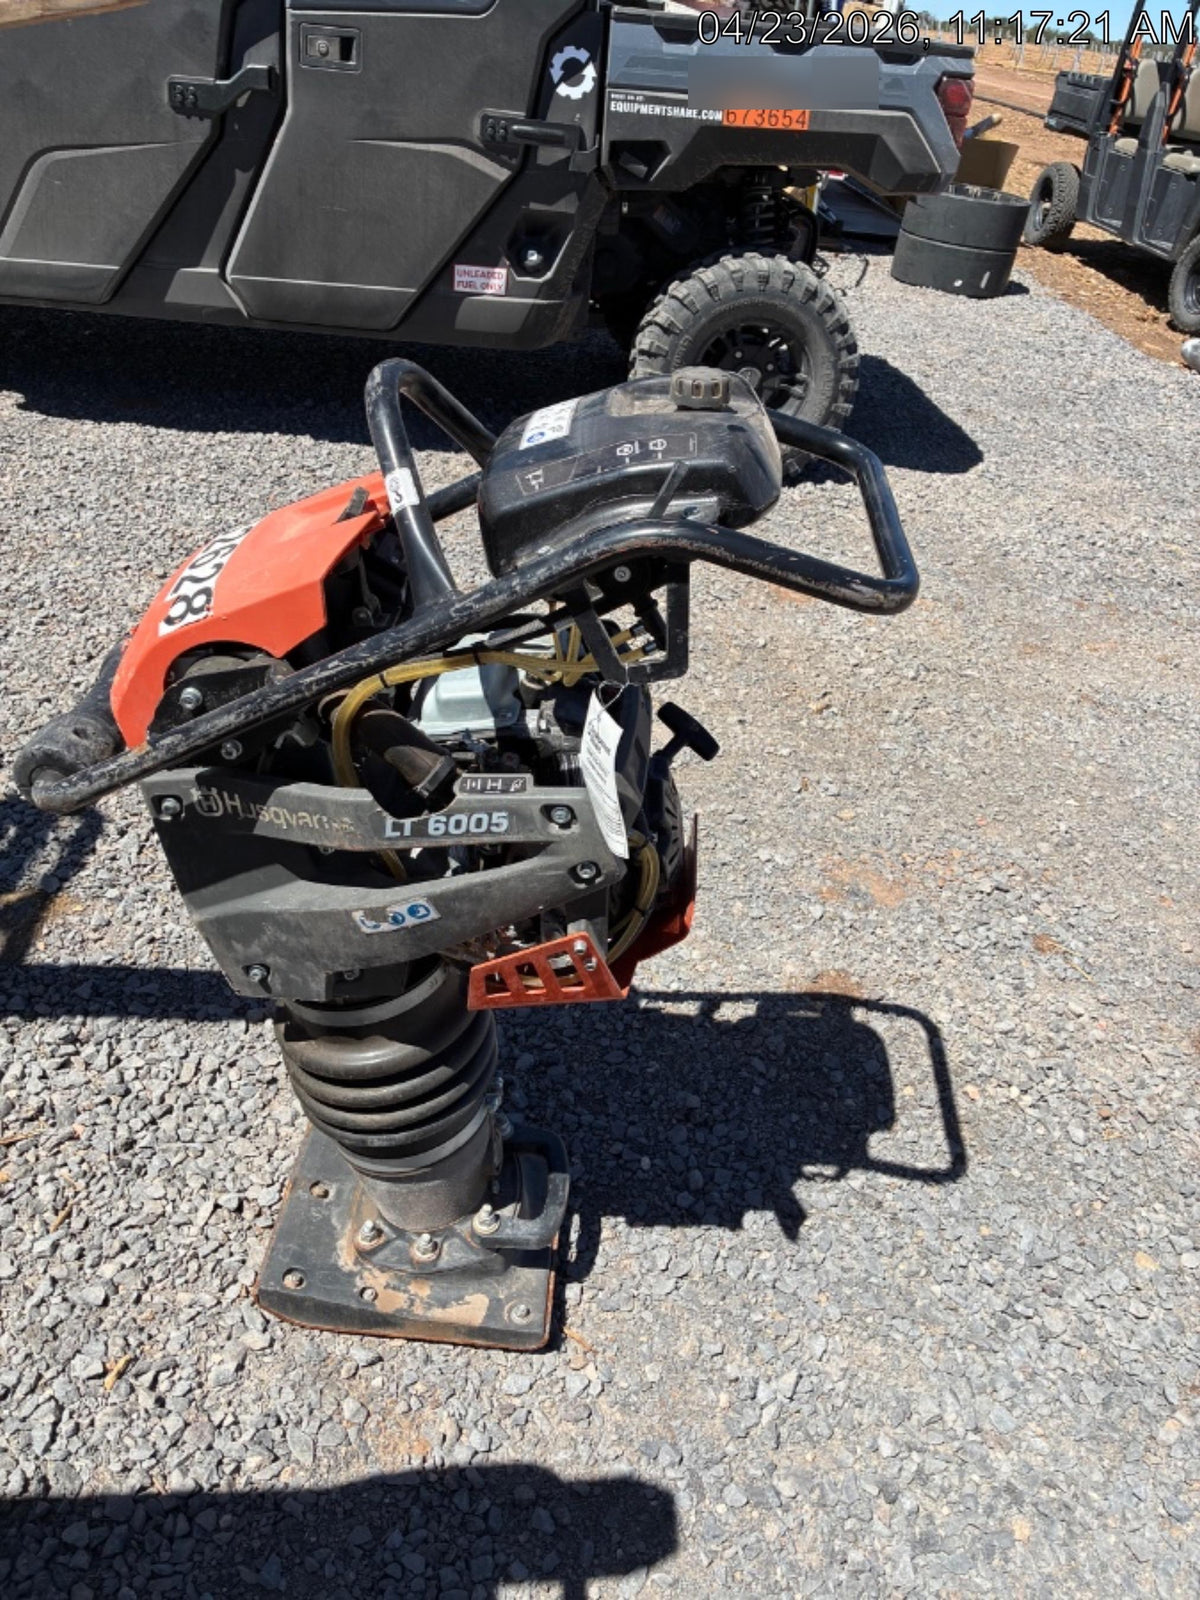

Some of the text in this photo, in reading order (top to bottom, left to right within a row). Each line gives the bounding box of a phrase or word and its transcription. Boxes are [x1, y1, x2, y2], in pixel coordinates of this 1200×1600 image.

[610, 100, 723, 122] EQUIPMENTSHARE.COM
[726, 109, 807, 129] 673654
[456, 268, 504, 280] UNLEADED
[480, 282, 504, 291] ONLY
[384, 811, 509, 839] LT 6005
